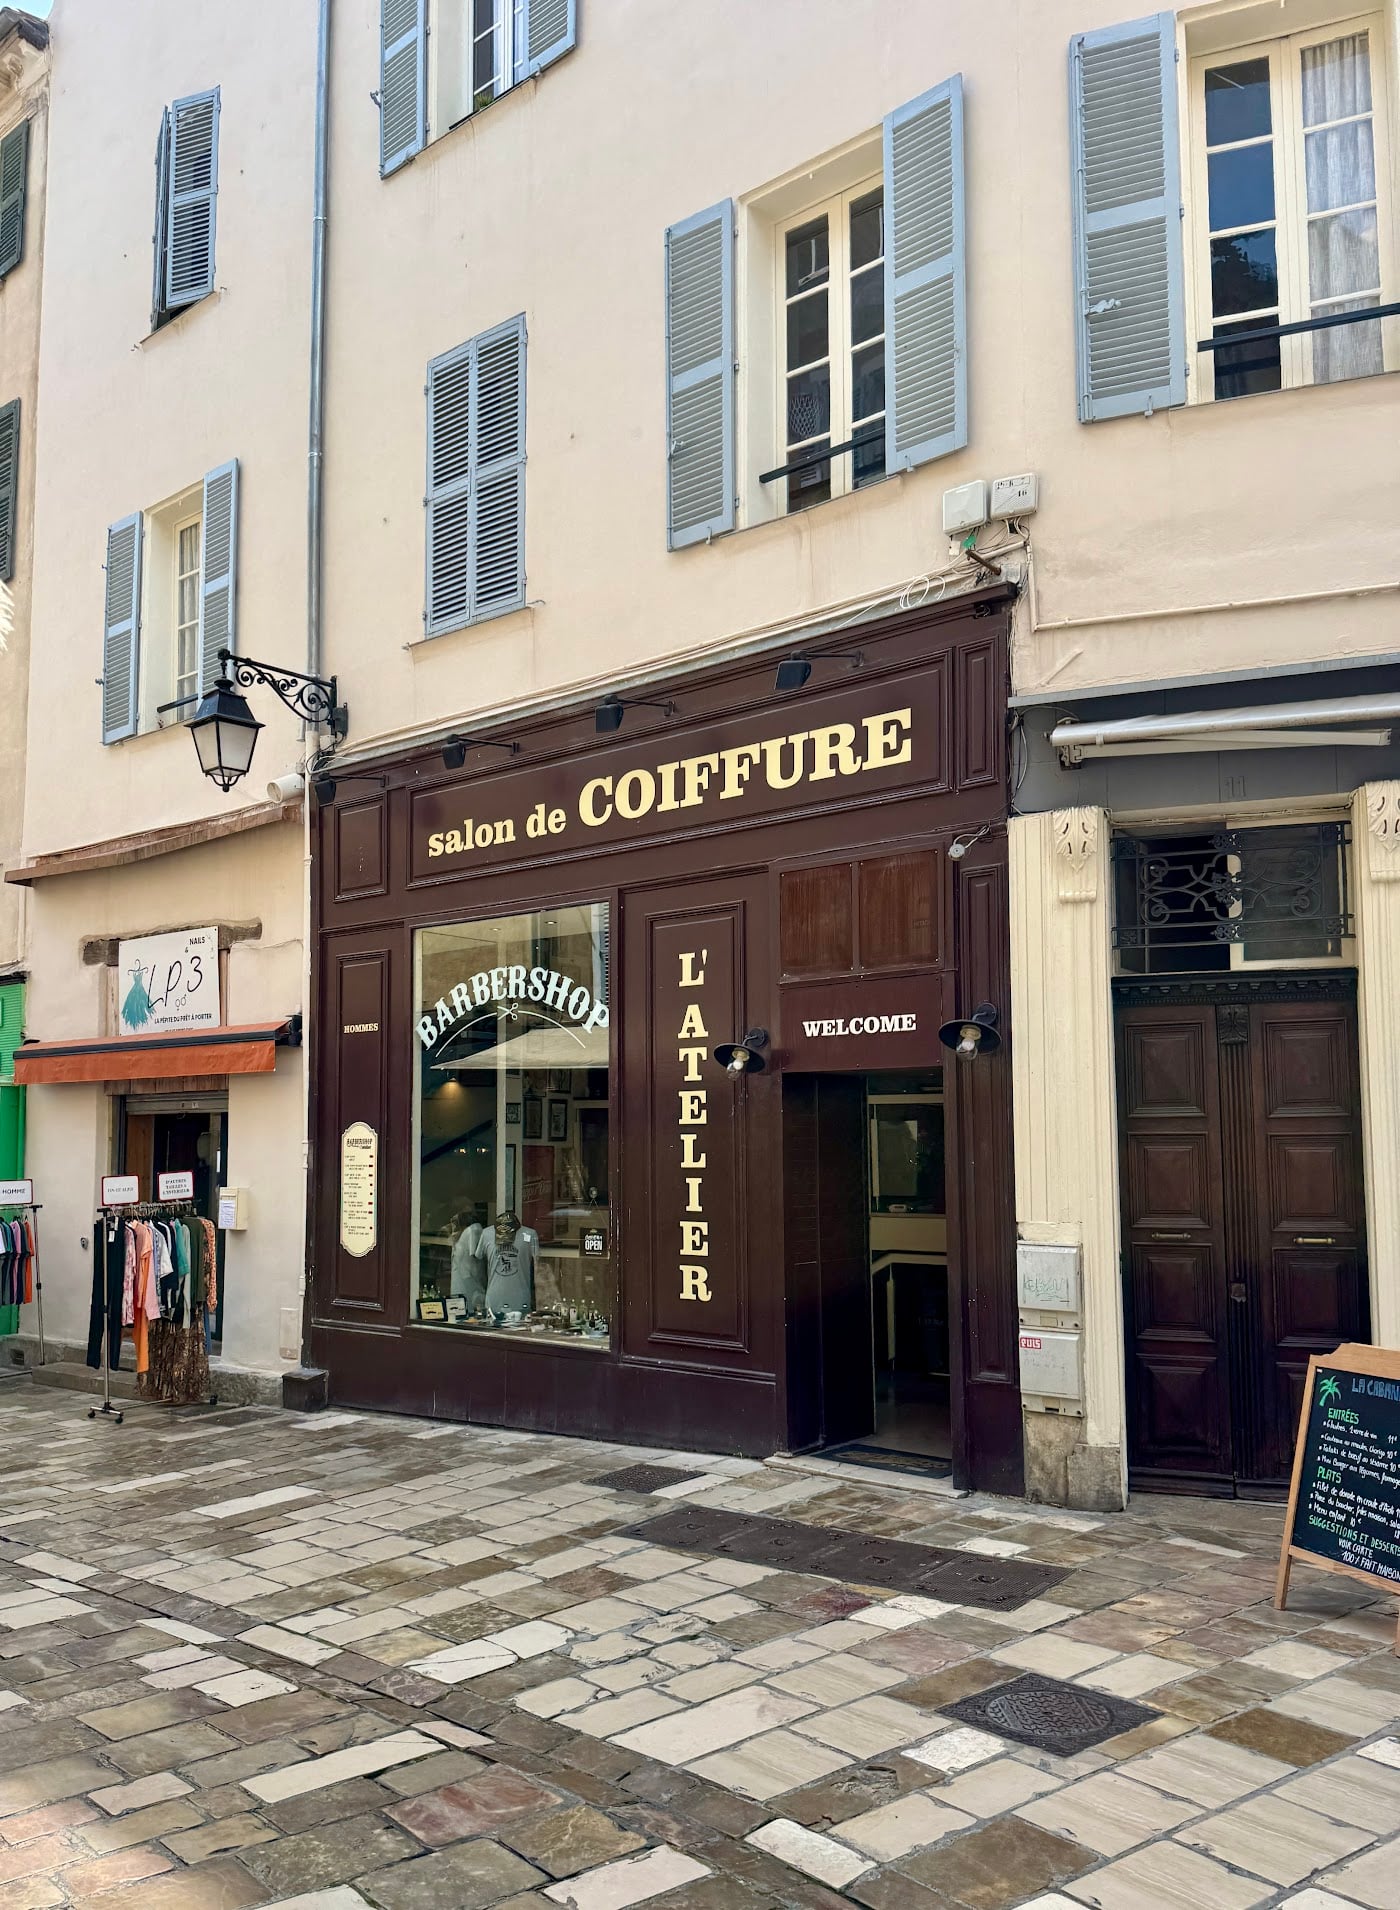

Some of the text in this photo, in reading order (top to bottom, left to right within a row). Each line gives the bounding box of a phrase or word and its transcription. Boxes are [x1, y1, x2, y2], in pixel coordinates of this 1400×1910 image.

[428, 707, 912, 857] salon de COIFFURE
[189, 936, 206, 946] NAILS
[415, 964, 610, 1050] BARBERSHOP
[343, 1023, 379, 1034] HOMMES
[802, 1013, 917, 1038] WELCOME
[585, 1240, 603, 1251] OPEN
[1352, 1378, 1366, 1394] LA
[1328, 1408, 1359, 1425] ENTRÉES
[1317, 1466, 1342, 1484] PLATS
[1313, 1501, 1328, 1516] Menu
[1308, 1514, 1358, 1541] SUGGESTIONS
[1359, 1532, 1370, 1545] ET
[1338, 1537, 1374, 1559] VOIR CARTE
[1360, 1557, 1378, 1574] FAIT
